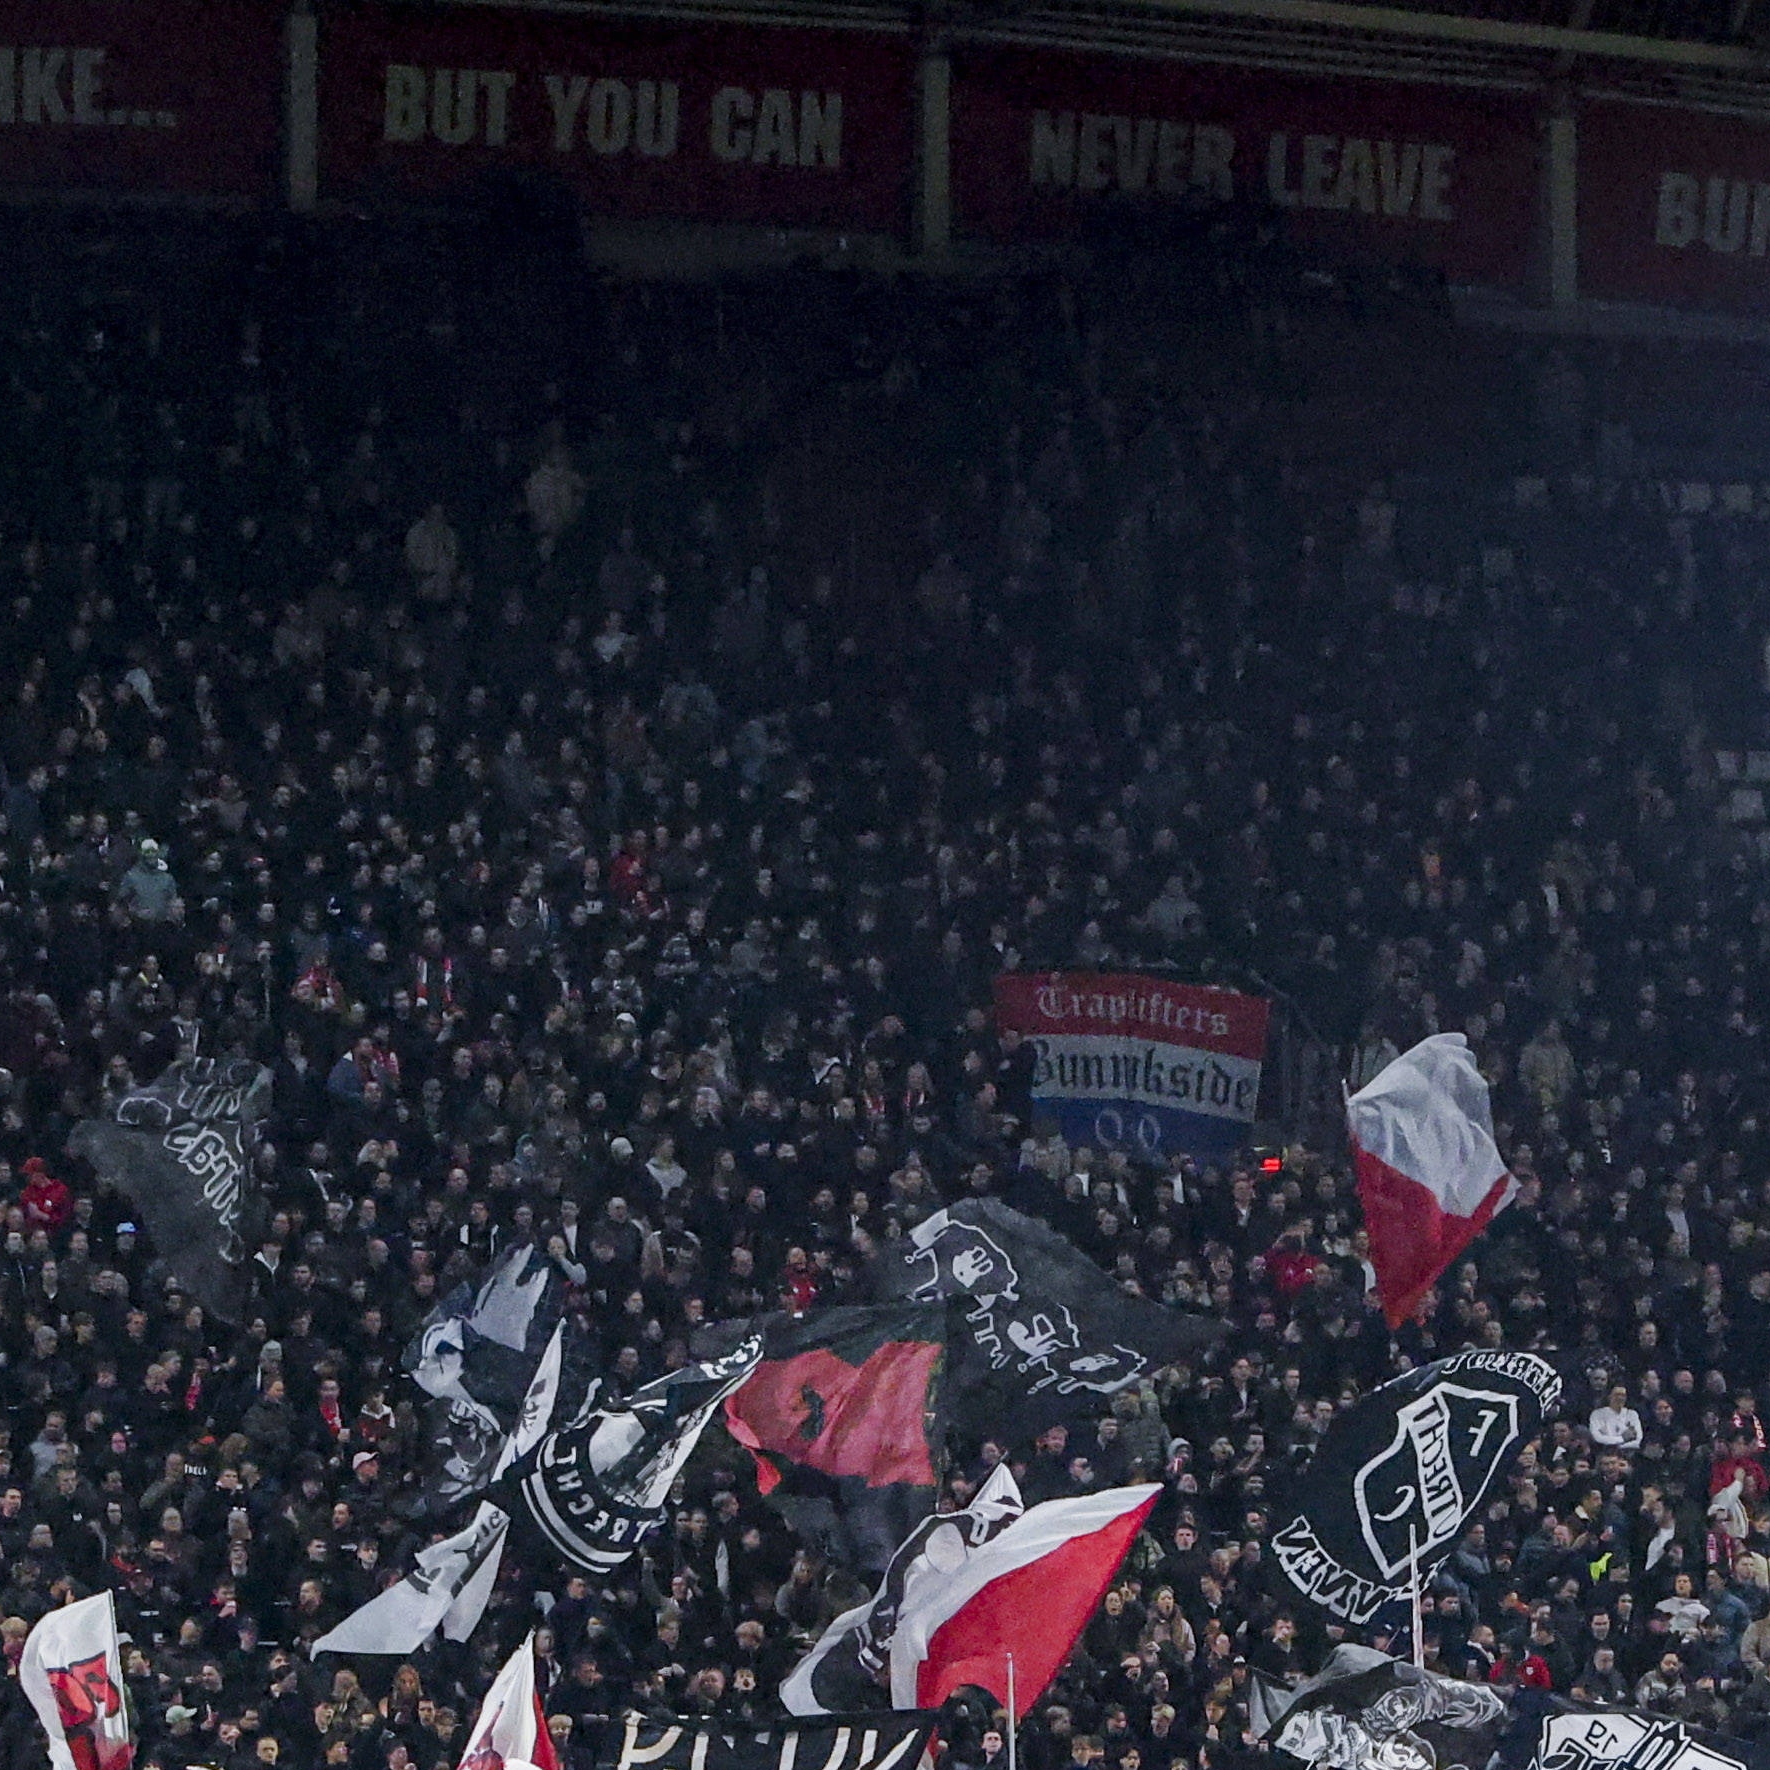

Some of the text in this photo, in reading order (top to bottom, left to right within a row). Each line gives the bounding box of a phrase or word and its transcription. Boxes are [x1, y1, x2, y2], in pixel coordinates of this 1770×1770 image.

[384, 63, 842, 168] BUT YOU CAN
[1030, 108, 1456, 222] NEVER LEAVE
